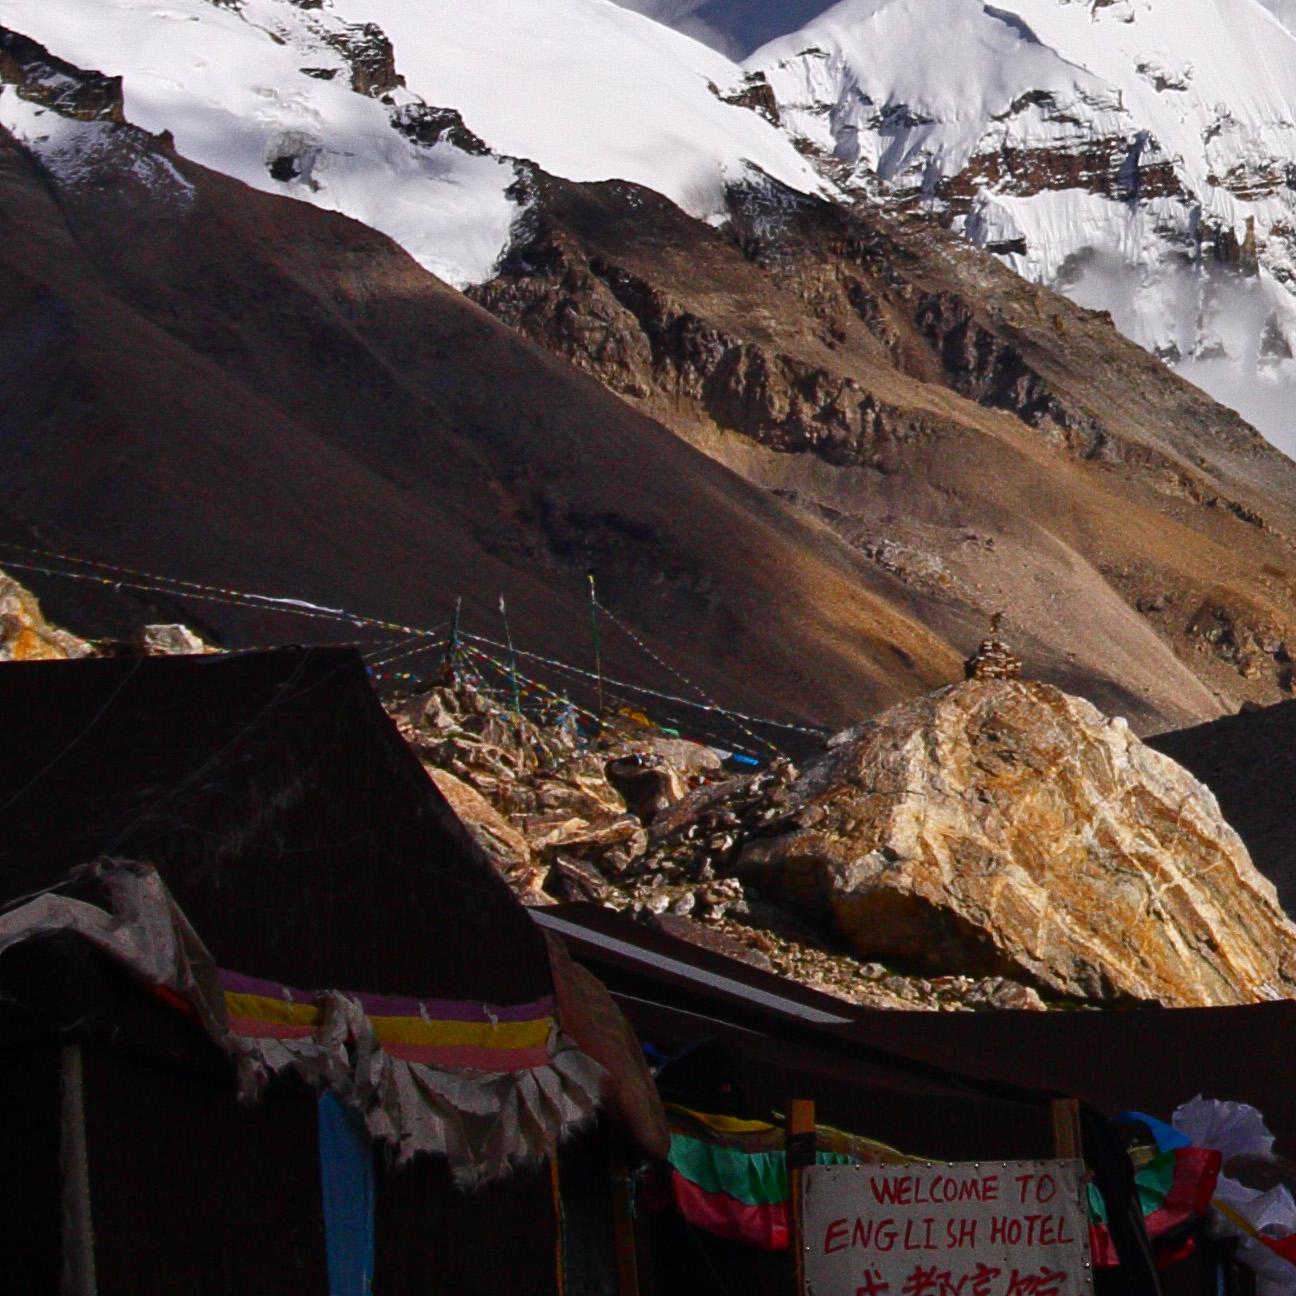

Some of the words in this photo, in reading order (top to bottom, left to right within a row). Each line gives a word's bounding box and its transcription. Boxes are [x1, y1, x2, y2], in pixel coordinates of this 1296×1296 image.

[870, 1175, 998, 1204] WELCOME
[1016, 1174, 1056, 1203] TO
[824, 1217, 977, 1254] ENGLISH
[990, 1215, 1074, 1247] HOTEL
